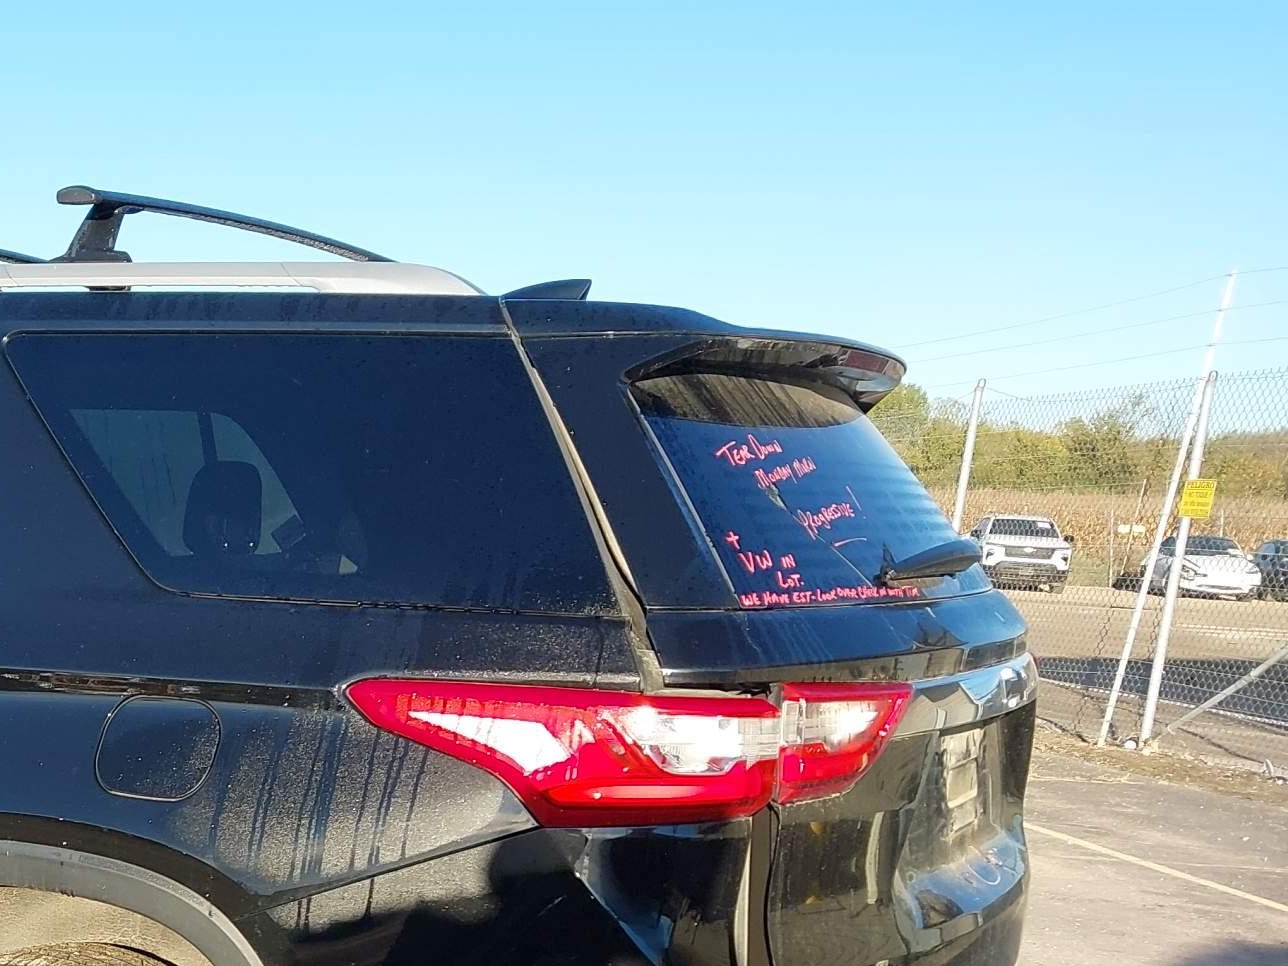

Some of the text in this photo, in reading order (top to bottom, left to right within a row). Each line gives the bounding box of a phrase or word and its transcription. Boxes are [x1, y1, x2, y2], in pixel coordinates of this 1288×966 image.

[738, 549, 796, 573] VW IN
[740, 593, 761, 606] WE
[763, 591, 790, 605] HAVE
